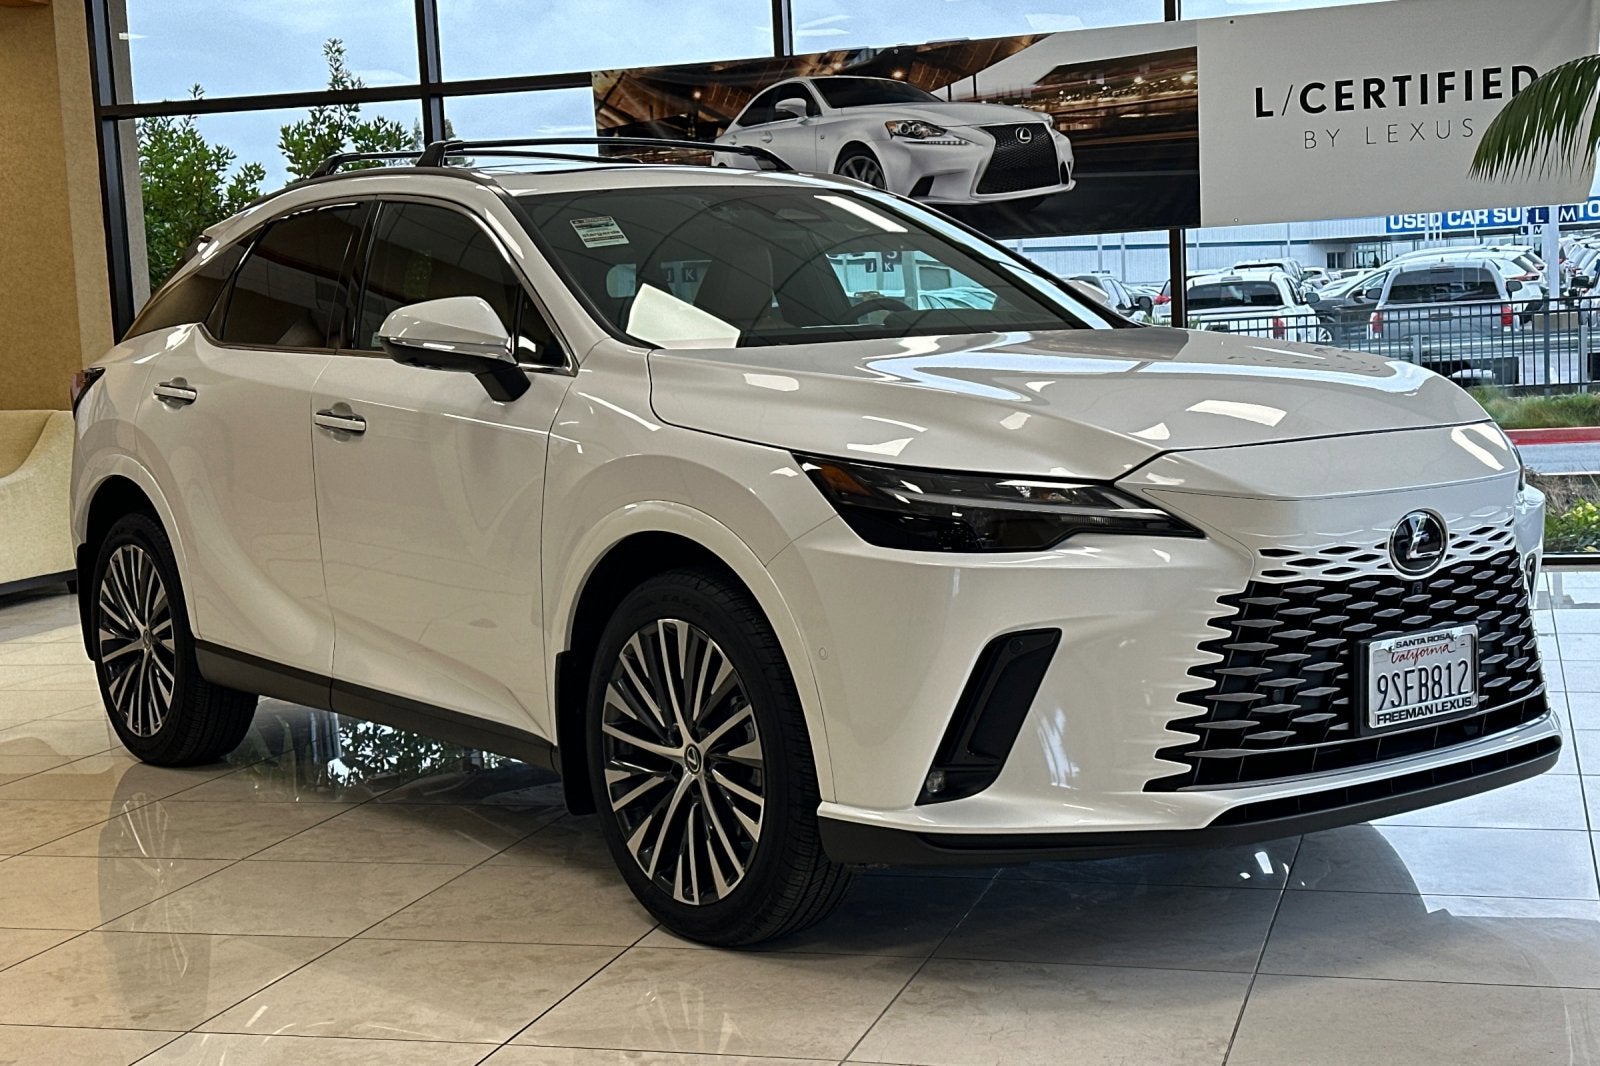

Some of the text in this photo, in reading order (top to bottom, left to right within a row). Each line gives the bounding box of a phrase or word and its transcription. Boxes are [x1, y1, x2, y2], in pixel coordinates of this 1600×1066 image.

[1255, 65, 1538, 118] L/CERTIFIED
[1304, 118, 1474, 149] BY LEXUS
[1389, 212, 1442, 229] USED
[1447, 208, 1488, 226] CAR
[1535, 209, 1544, 222] L
[1559, 207, 1576, 221] M
[685, 269, 695, 280] K
[884, 262, 892, 271] K
[1395, 633, 1453, 648] SANTA ROSA
[1391, 643, 1455, 665] California
[1377, 659, 1469, 711] 9SFB812
[1376, 697, 1472, 725] FREEMAN LEXUS
